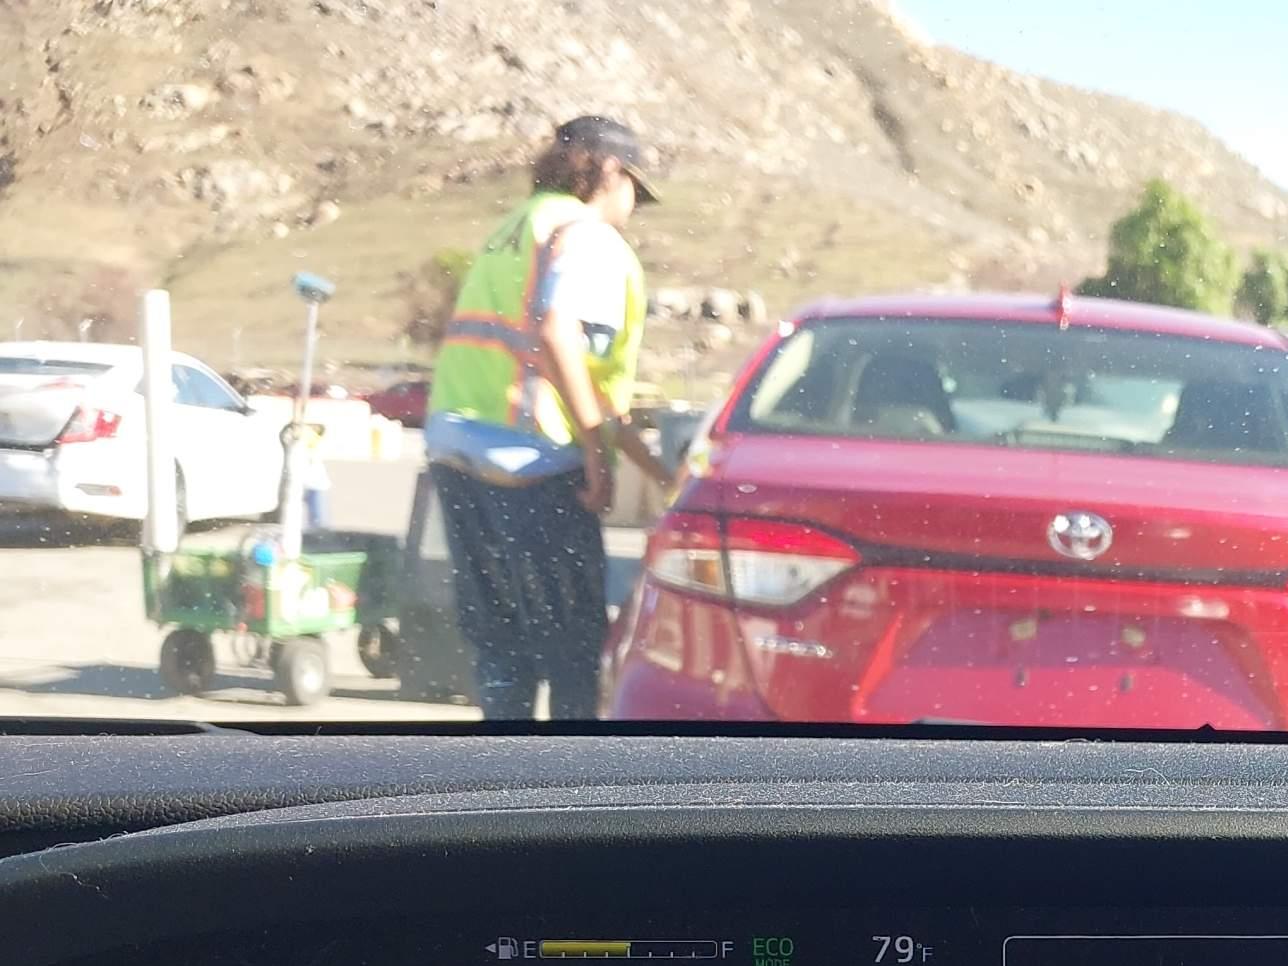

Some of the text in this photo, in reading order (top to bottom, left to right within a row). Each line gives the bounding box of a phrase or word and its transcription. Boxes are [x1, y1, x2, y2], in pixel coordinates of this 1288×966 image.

[524, 941, 536, 958] E
[722, 941, 733, 958] F
[754, 938, 793, 956] ECO
